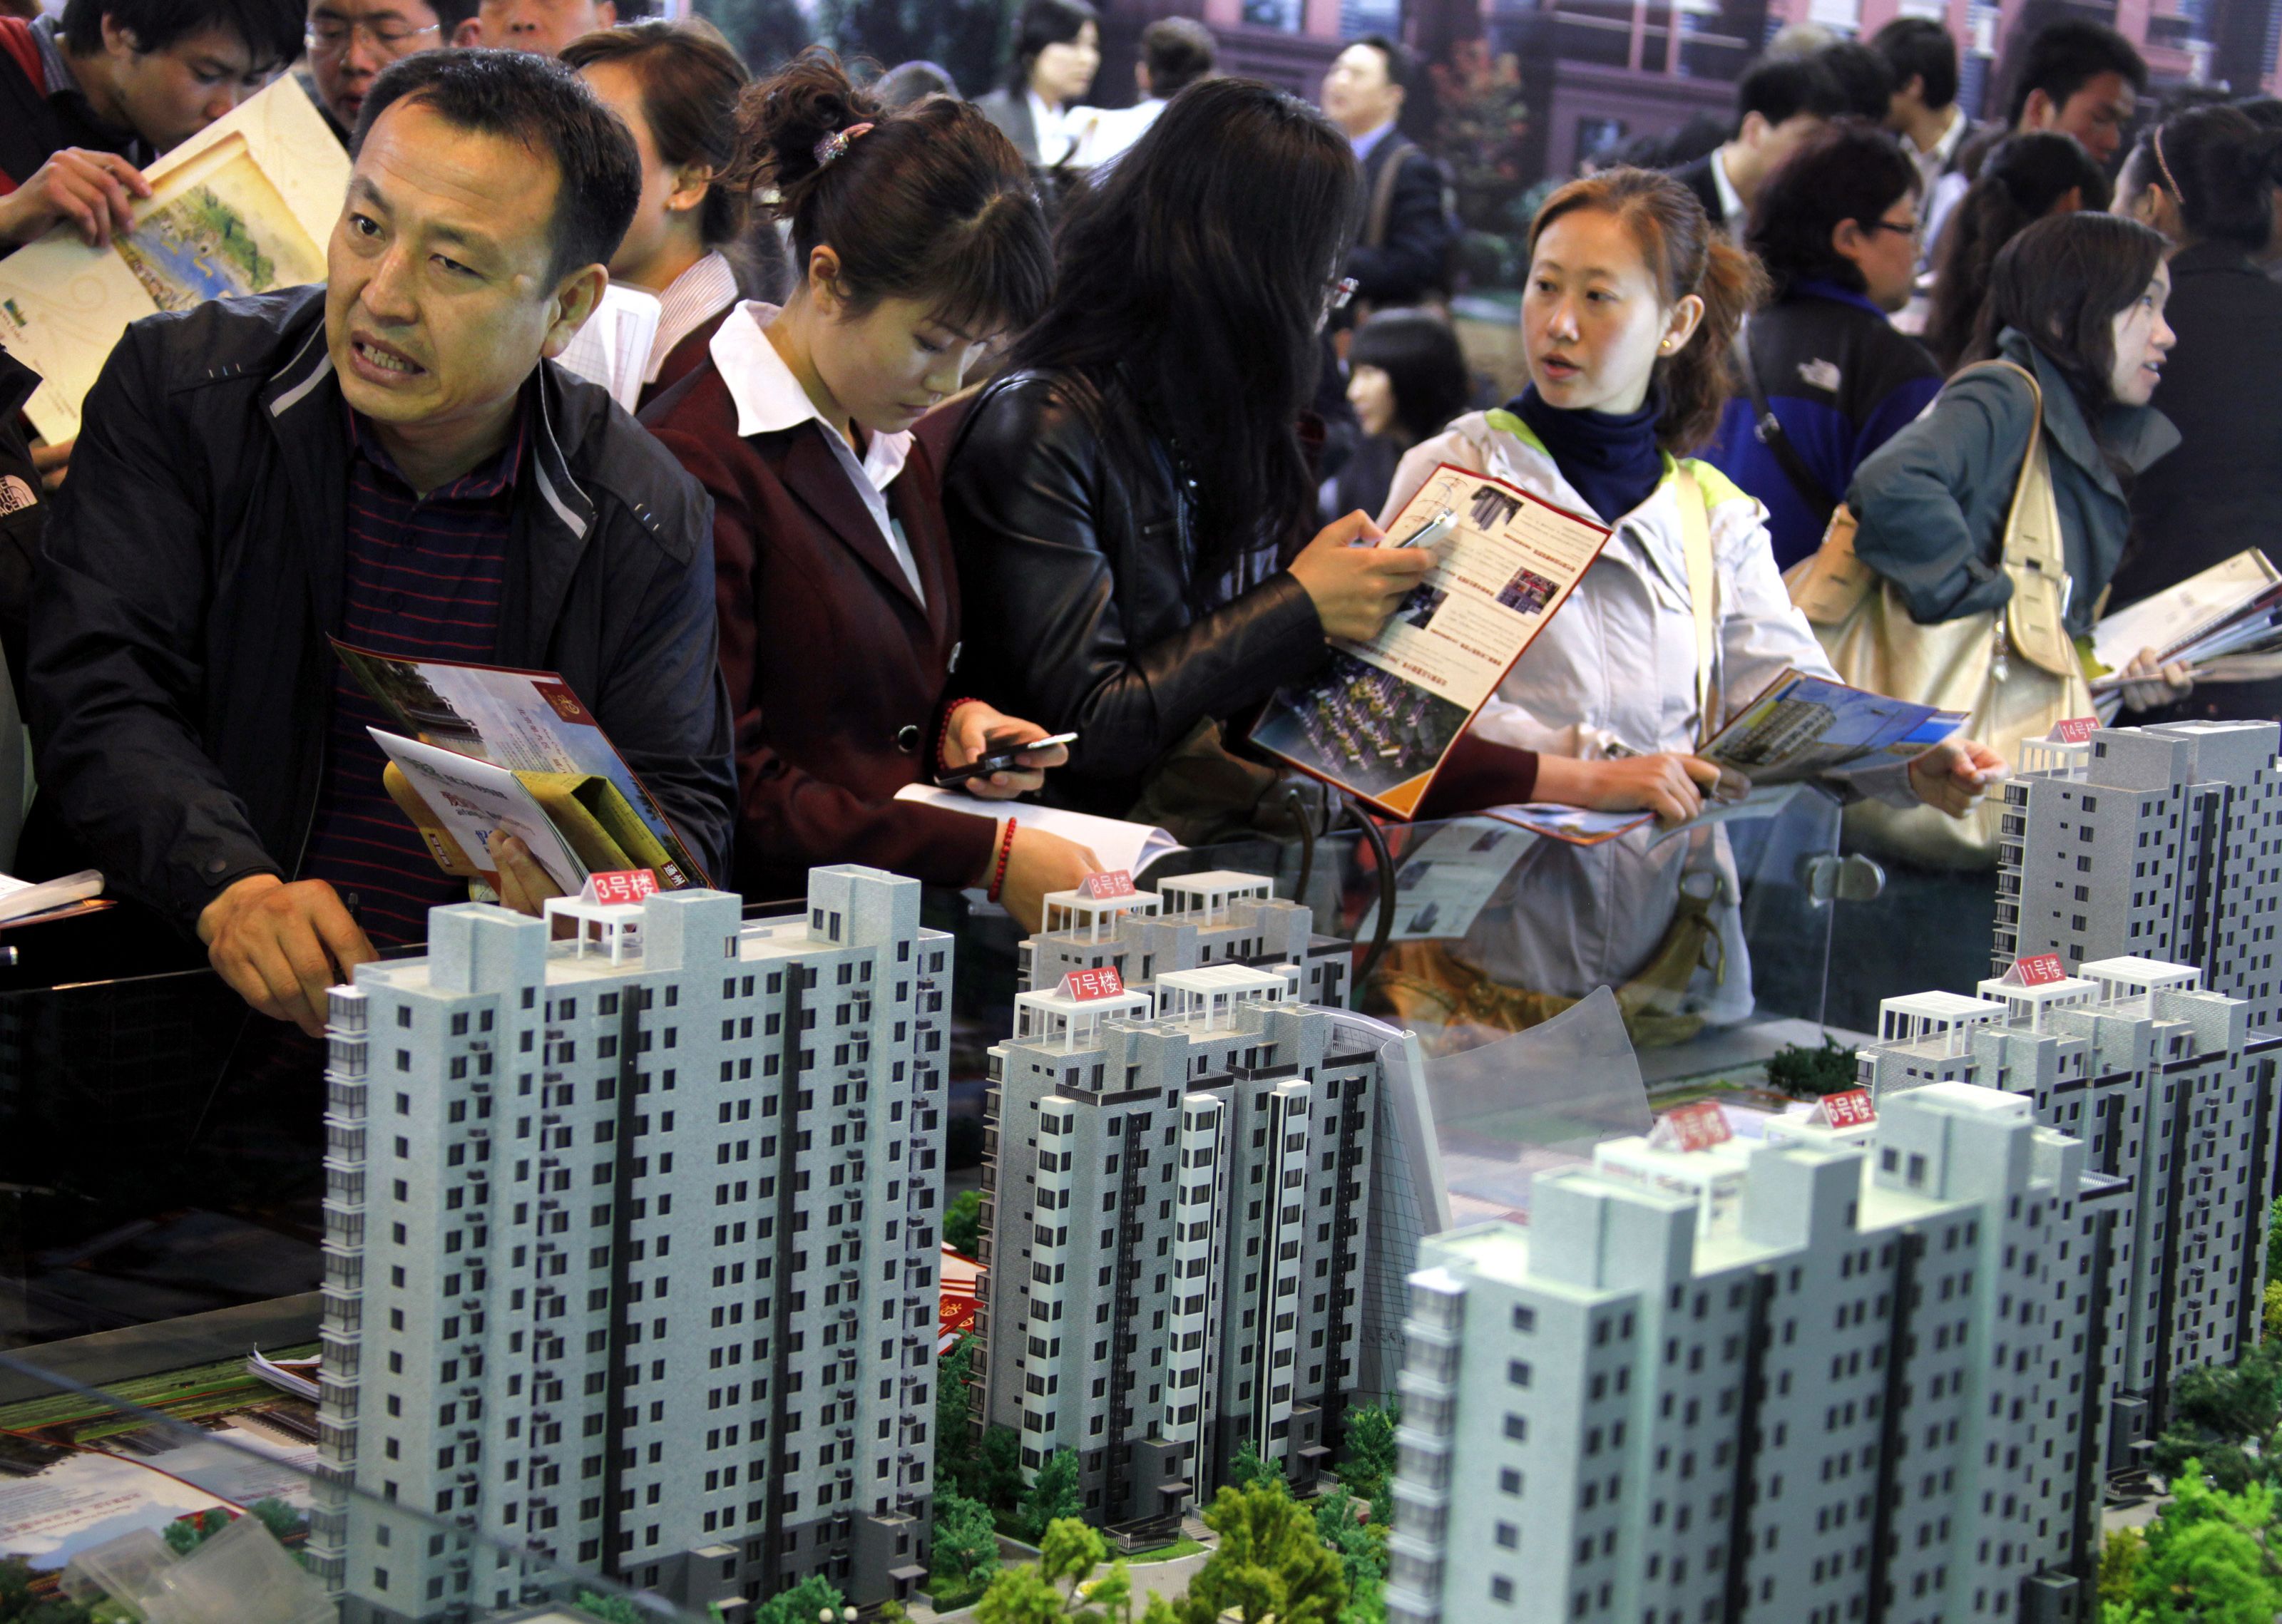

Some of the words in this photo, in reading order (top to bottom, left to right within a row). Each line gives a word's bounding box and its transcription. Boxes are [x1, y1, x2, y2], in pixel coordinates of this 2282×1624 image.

[663, 863, 686, 886] 通州
[1092, 873, 1132, 894] 8号楼
[596, 874, 654, 900] 3号楼
[2021, 957, 2064, 981] 11号楼
[1071, 970, 1120, 995] 7号楼
[1826, 1094, 1872, 1123] 6号楼
